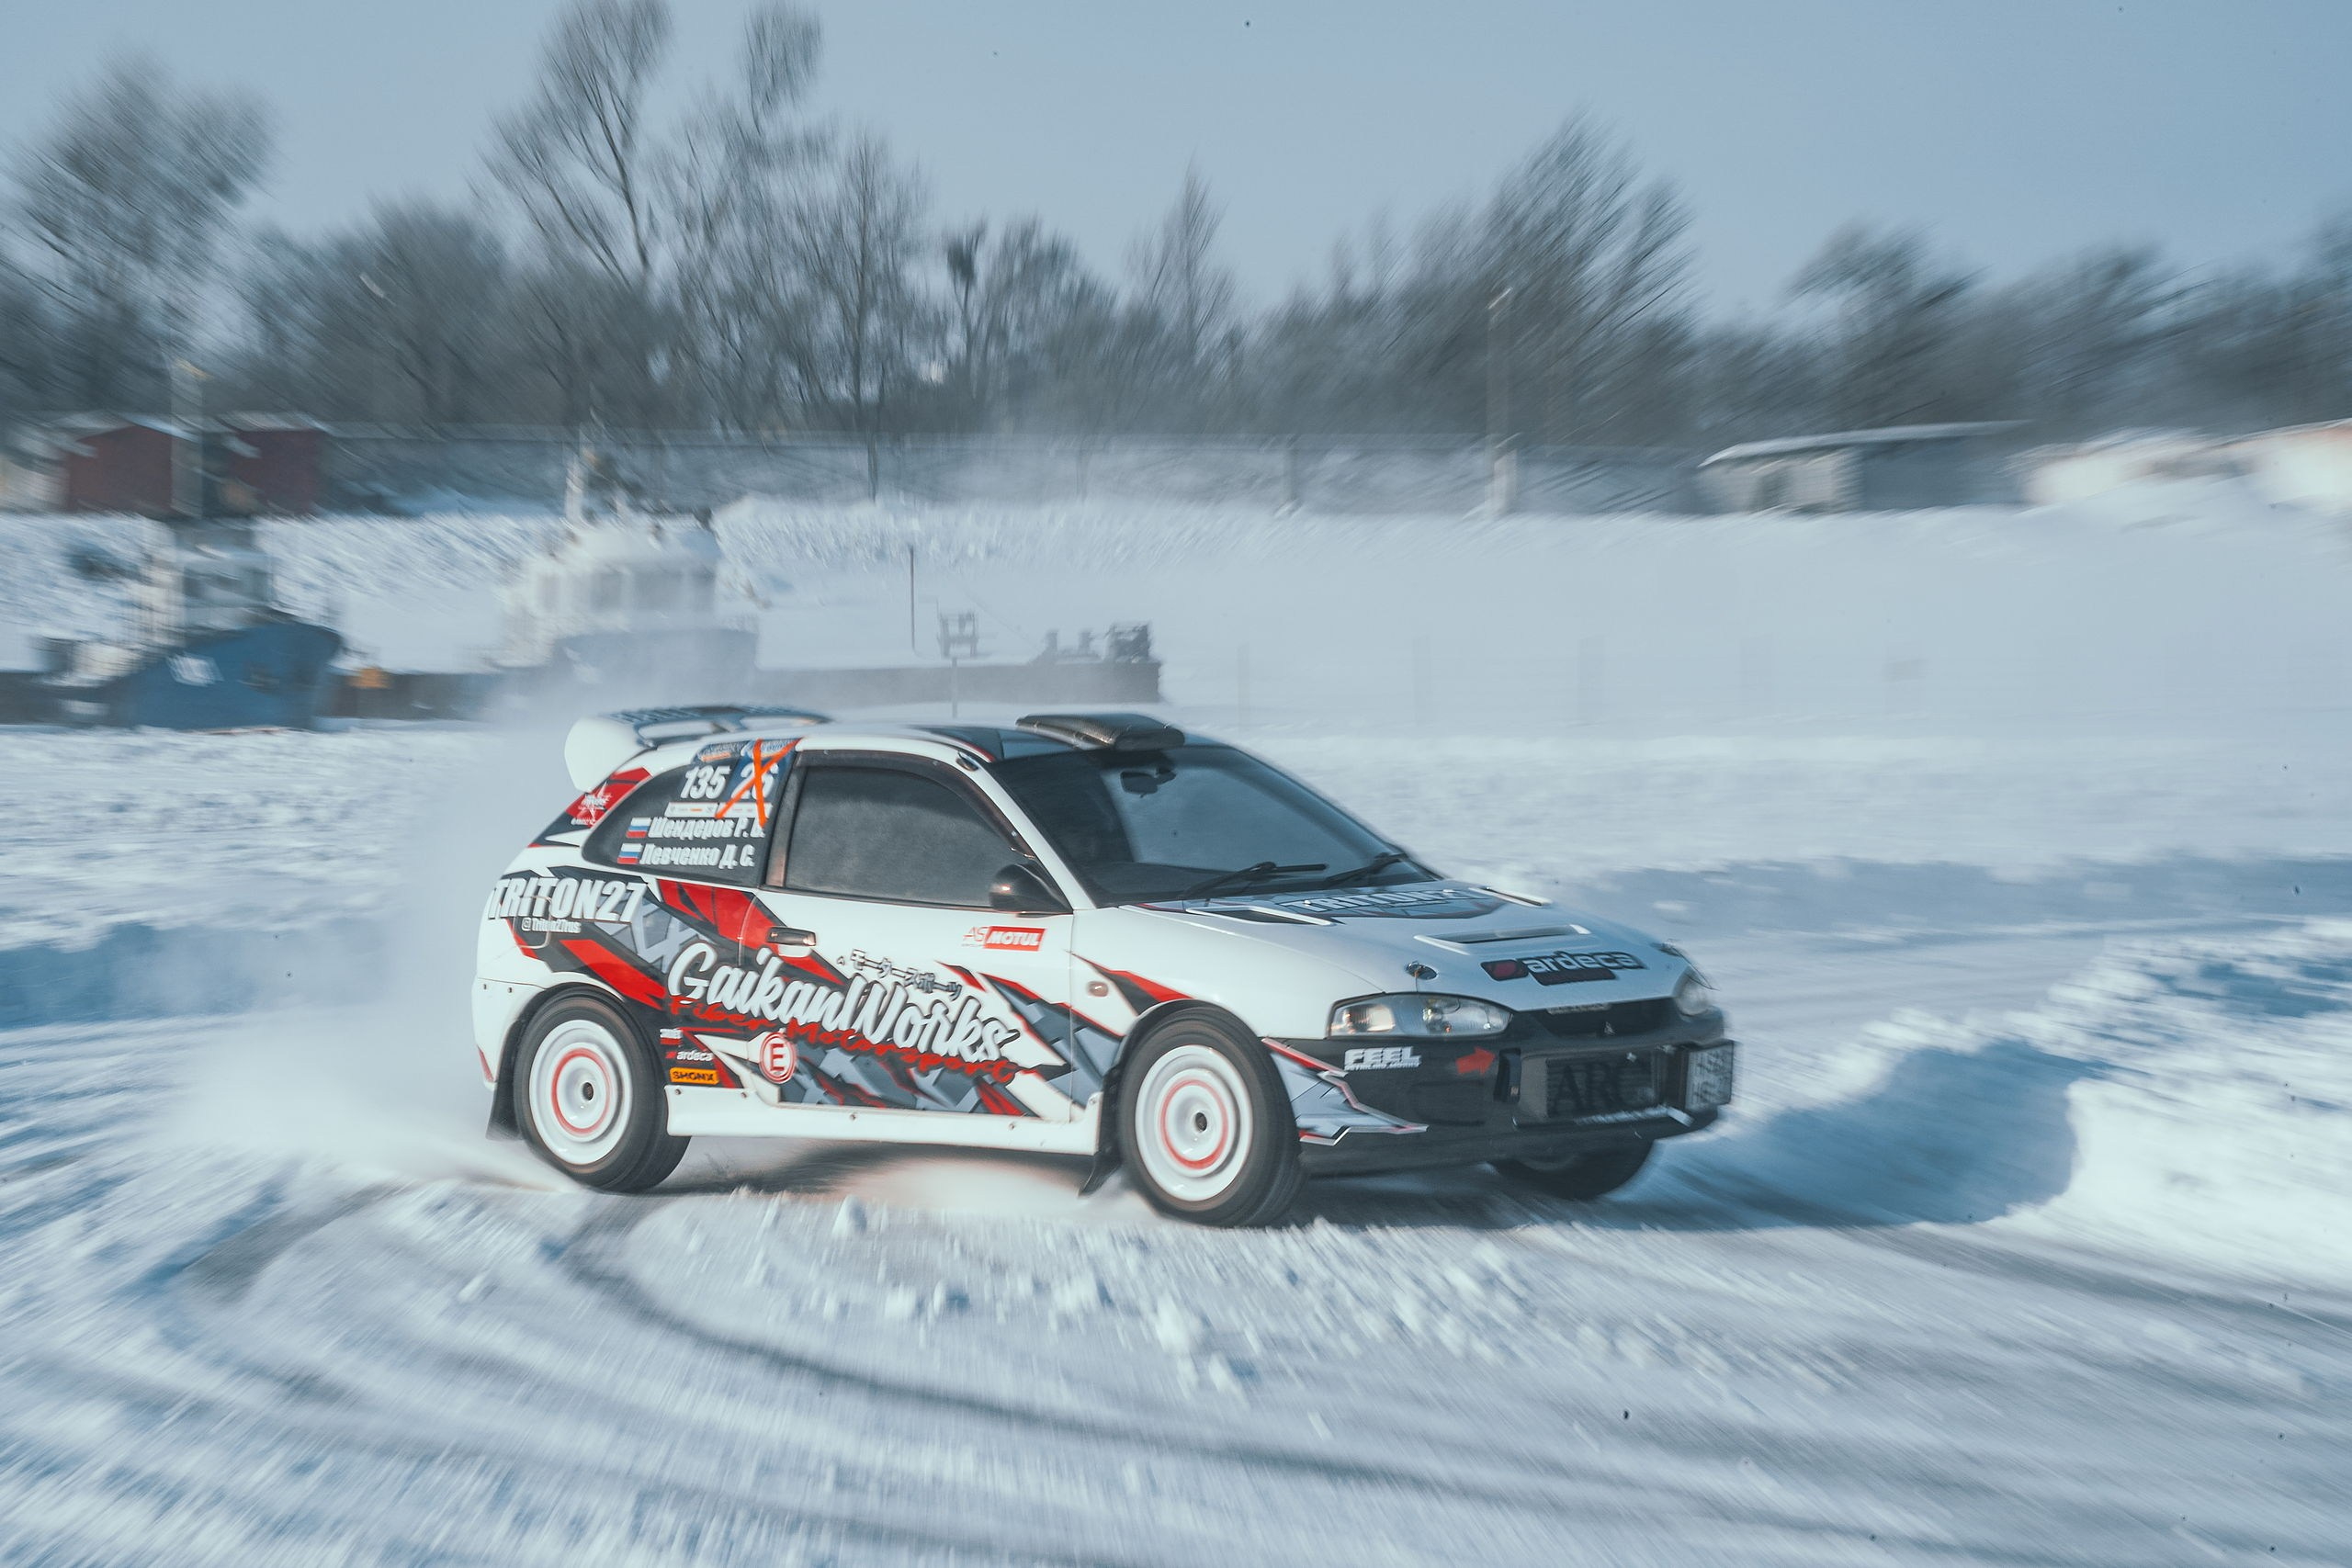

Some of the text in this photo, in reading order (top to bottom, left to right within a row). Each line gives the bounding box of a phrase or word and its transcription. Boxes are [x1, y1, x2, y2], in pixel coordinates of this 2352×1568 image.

[681, 764, 730, 799] 135
[488, 877, 646, 923] TRITON27
[987, 931, 1042, 947] MOTUL
[1521, 951, 1639, 974] ardeca
[676, 1049, 714, 1062] ardeca
